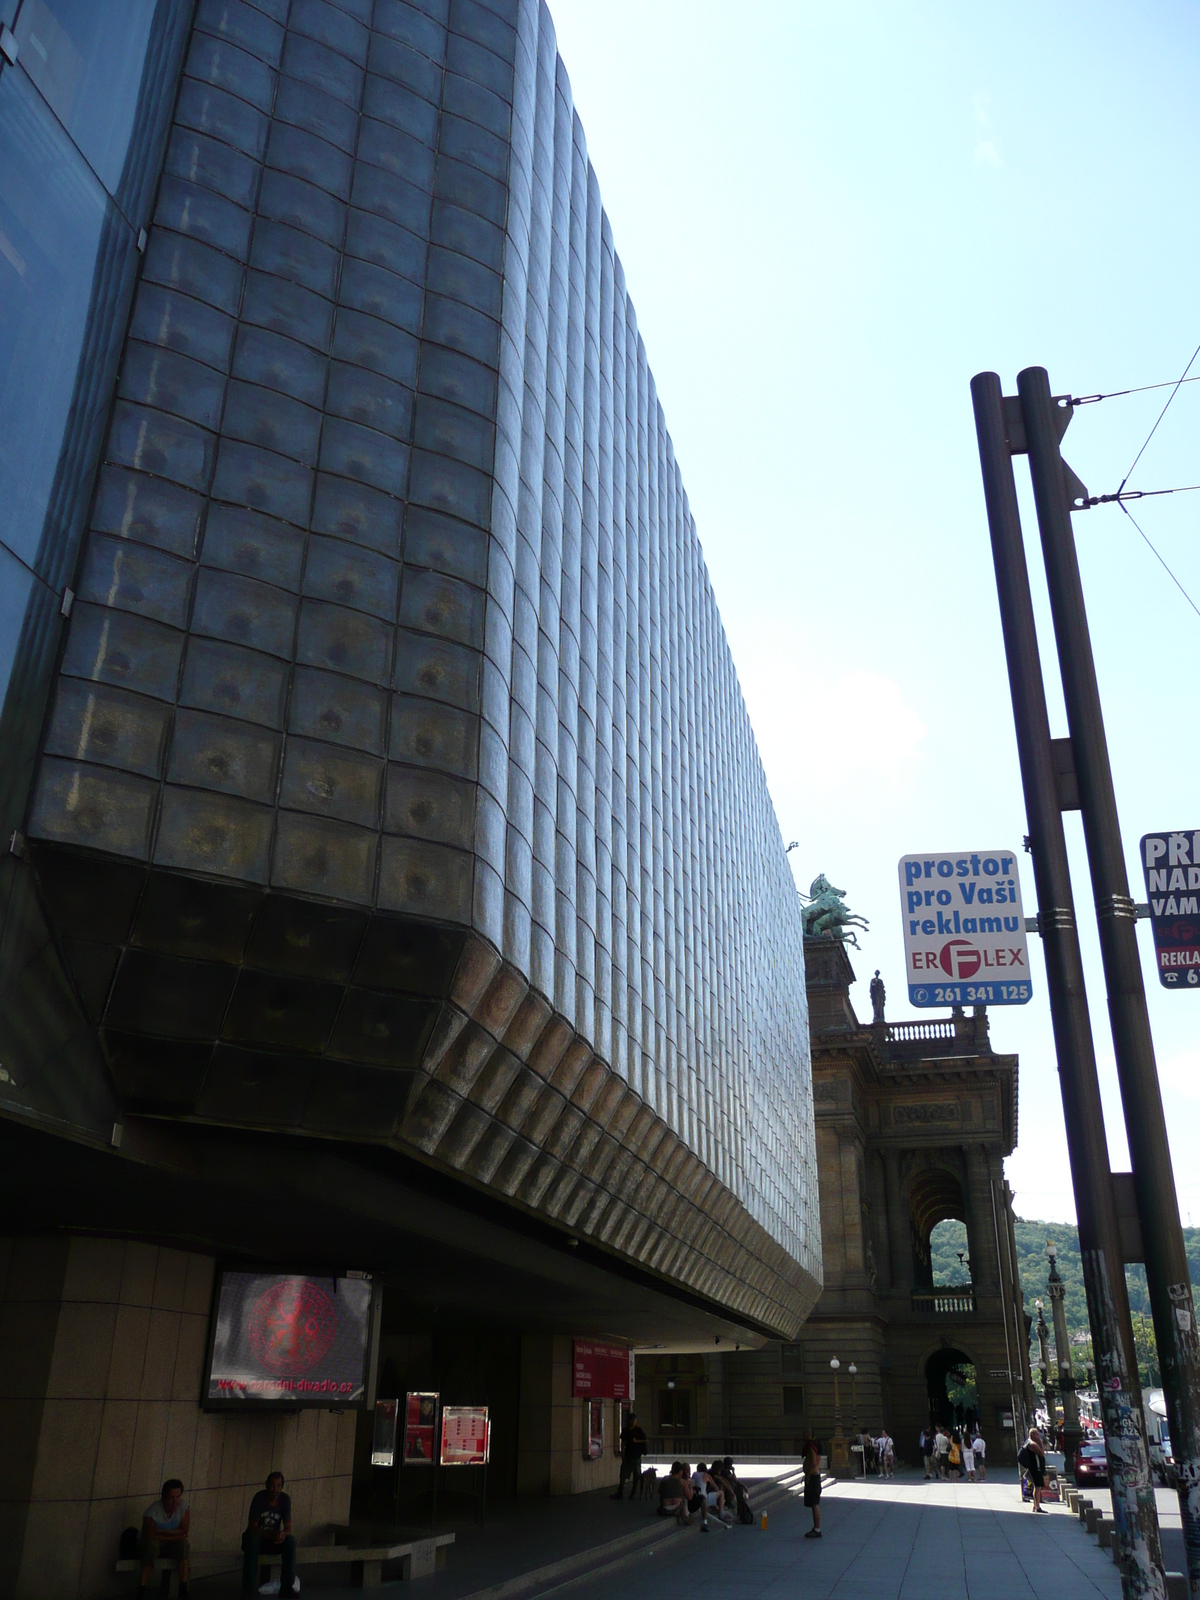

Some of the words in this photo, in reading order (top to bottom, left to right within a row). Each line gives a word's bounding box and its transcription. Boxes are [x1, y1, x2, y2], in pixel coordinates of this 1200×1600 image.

[904, 854, 1013, 886] prostor
[1149, 867, 1200, 892] NAD
[907, 889, 952, 914] pro
[958, 879, 1017, 905] Vaši
[1151, 894, 1200, 916] VÁM
[909, 910, 1019, 936] reklamu
[911, 939, 1025, 979] ERFLEX
[934, 987, 962, 1002] 261
[966, 986, 994, 1001] 341
[1000, 985, 1029, 1000] 125
